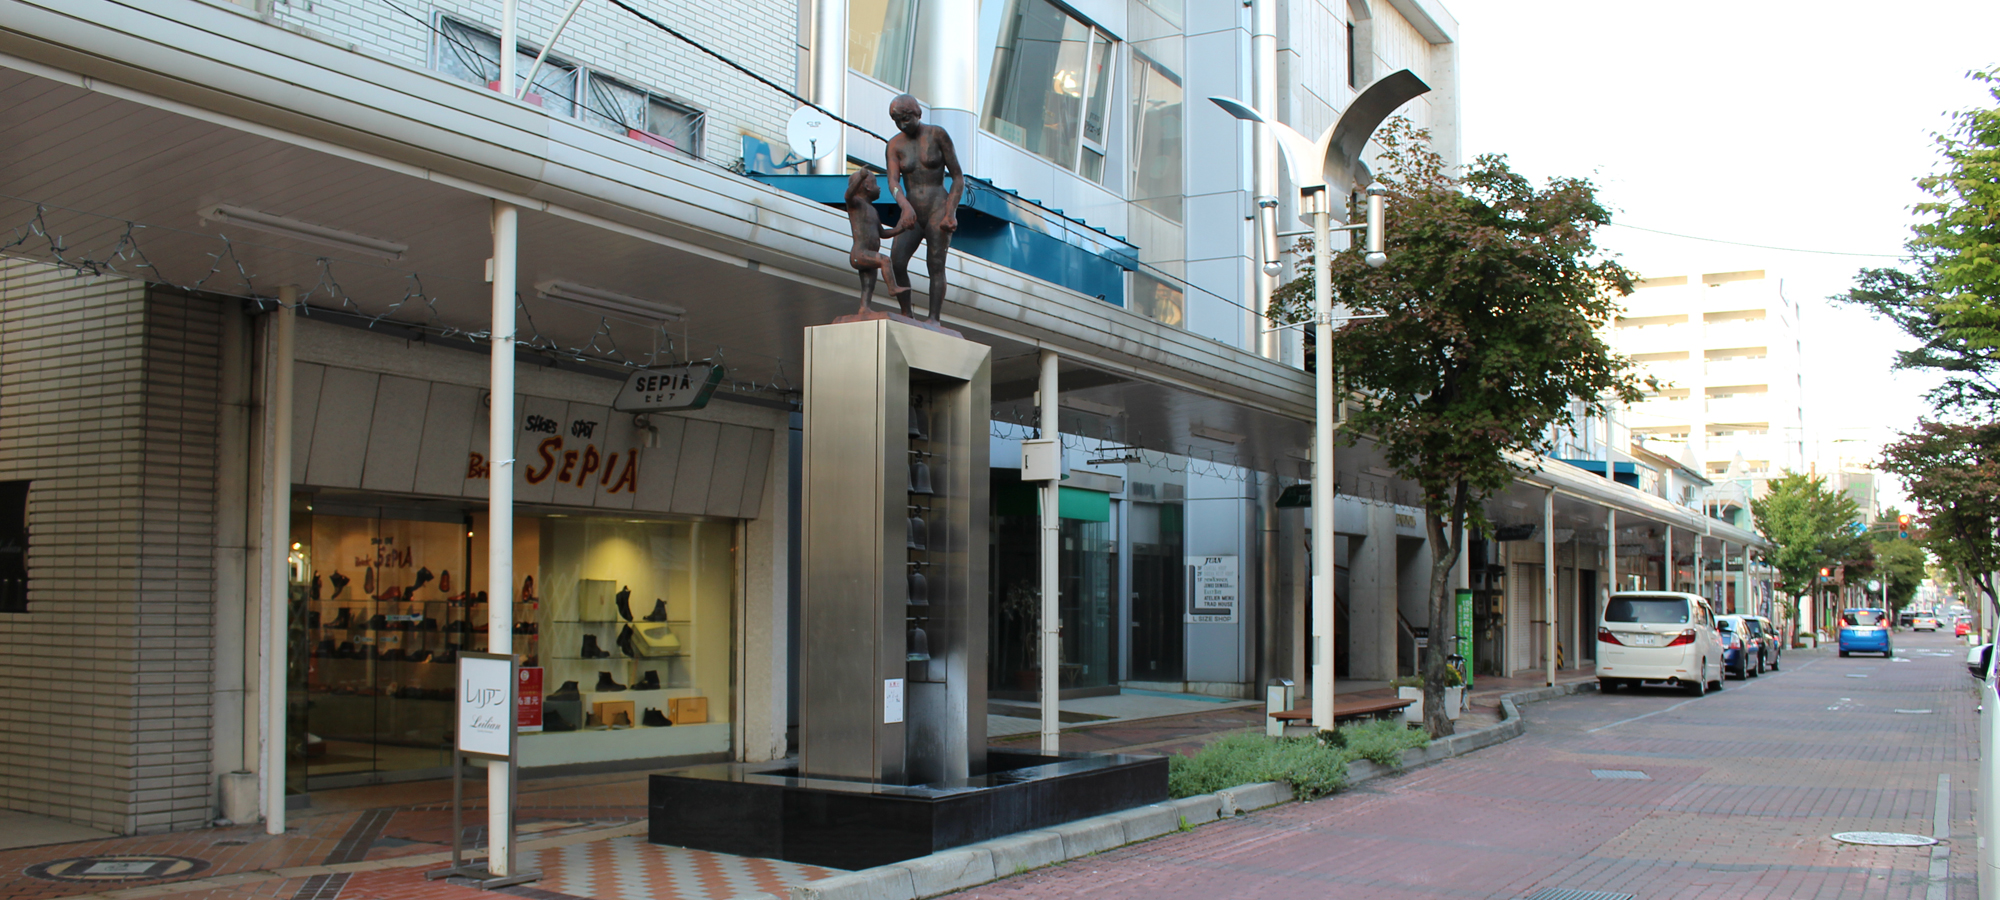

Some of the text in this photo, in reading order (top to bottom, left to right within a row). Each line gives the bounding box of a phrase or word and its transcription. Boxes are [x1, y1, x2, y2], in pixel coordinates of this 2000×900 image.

[635, 374, 690, 392] SEPIA
[525, 414, 598, 439] SHOES SPOT
[466, 435, 639, 495] Bri SEPIA
[467, 680, 506, 708] レリアン
